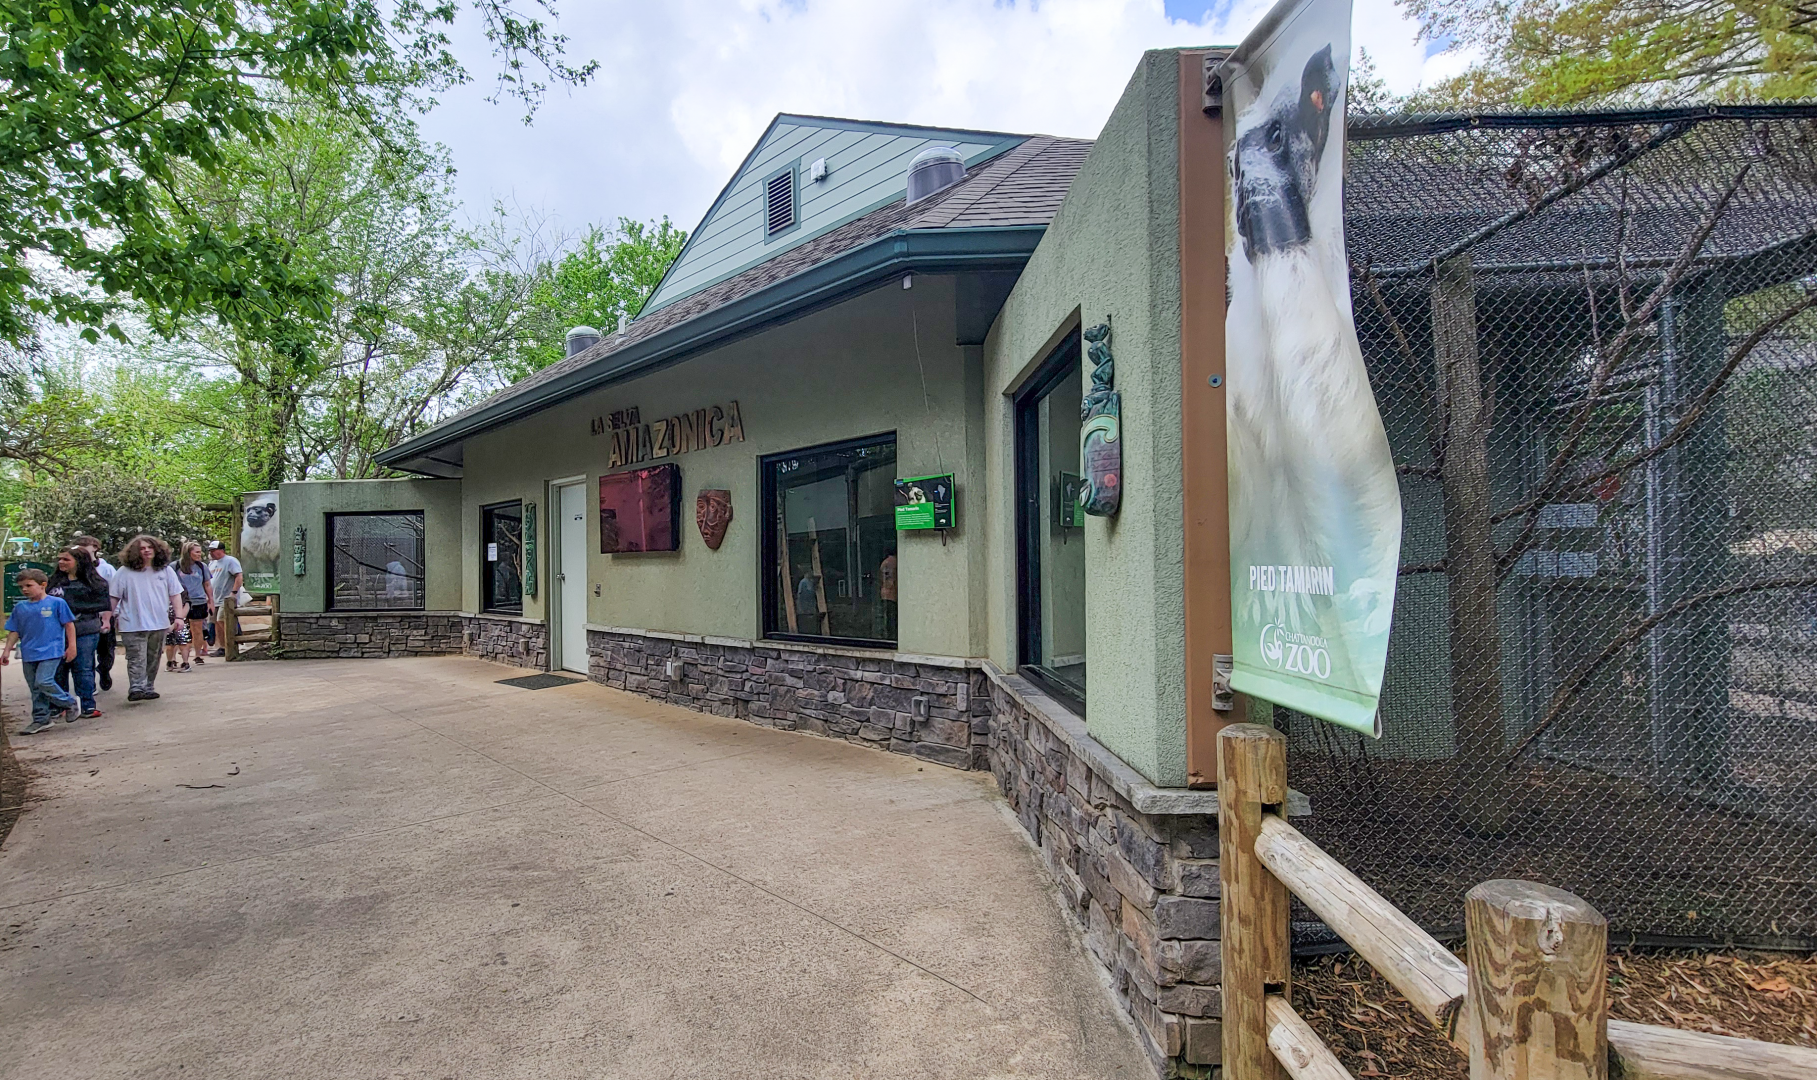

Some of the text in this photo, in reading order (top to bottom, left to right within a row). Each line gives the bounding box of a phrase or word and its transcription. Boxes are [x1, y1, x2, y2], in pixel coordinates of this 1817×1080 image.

[591, 417, 604, 435] LA
[608, 401, 745, 468] AMAZONICA
[1249, 565, 1334, 595] PIED TAMARIN
[1286, 632, 1328, 648] CHATTANOOGA
[1284, 643, 1332, 679] ZOO
